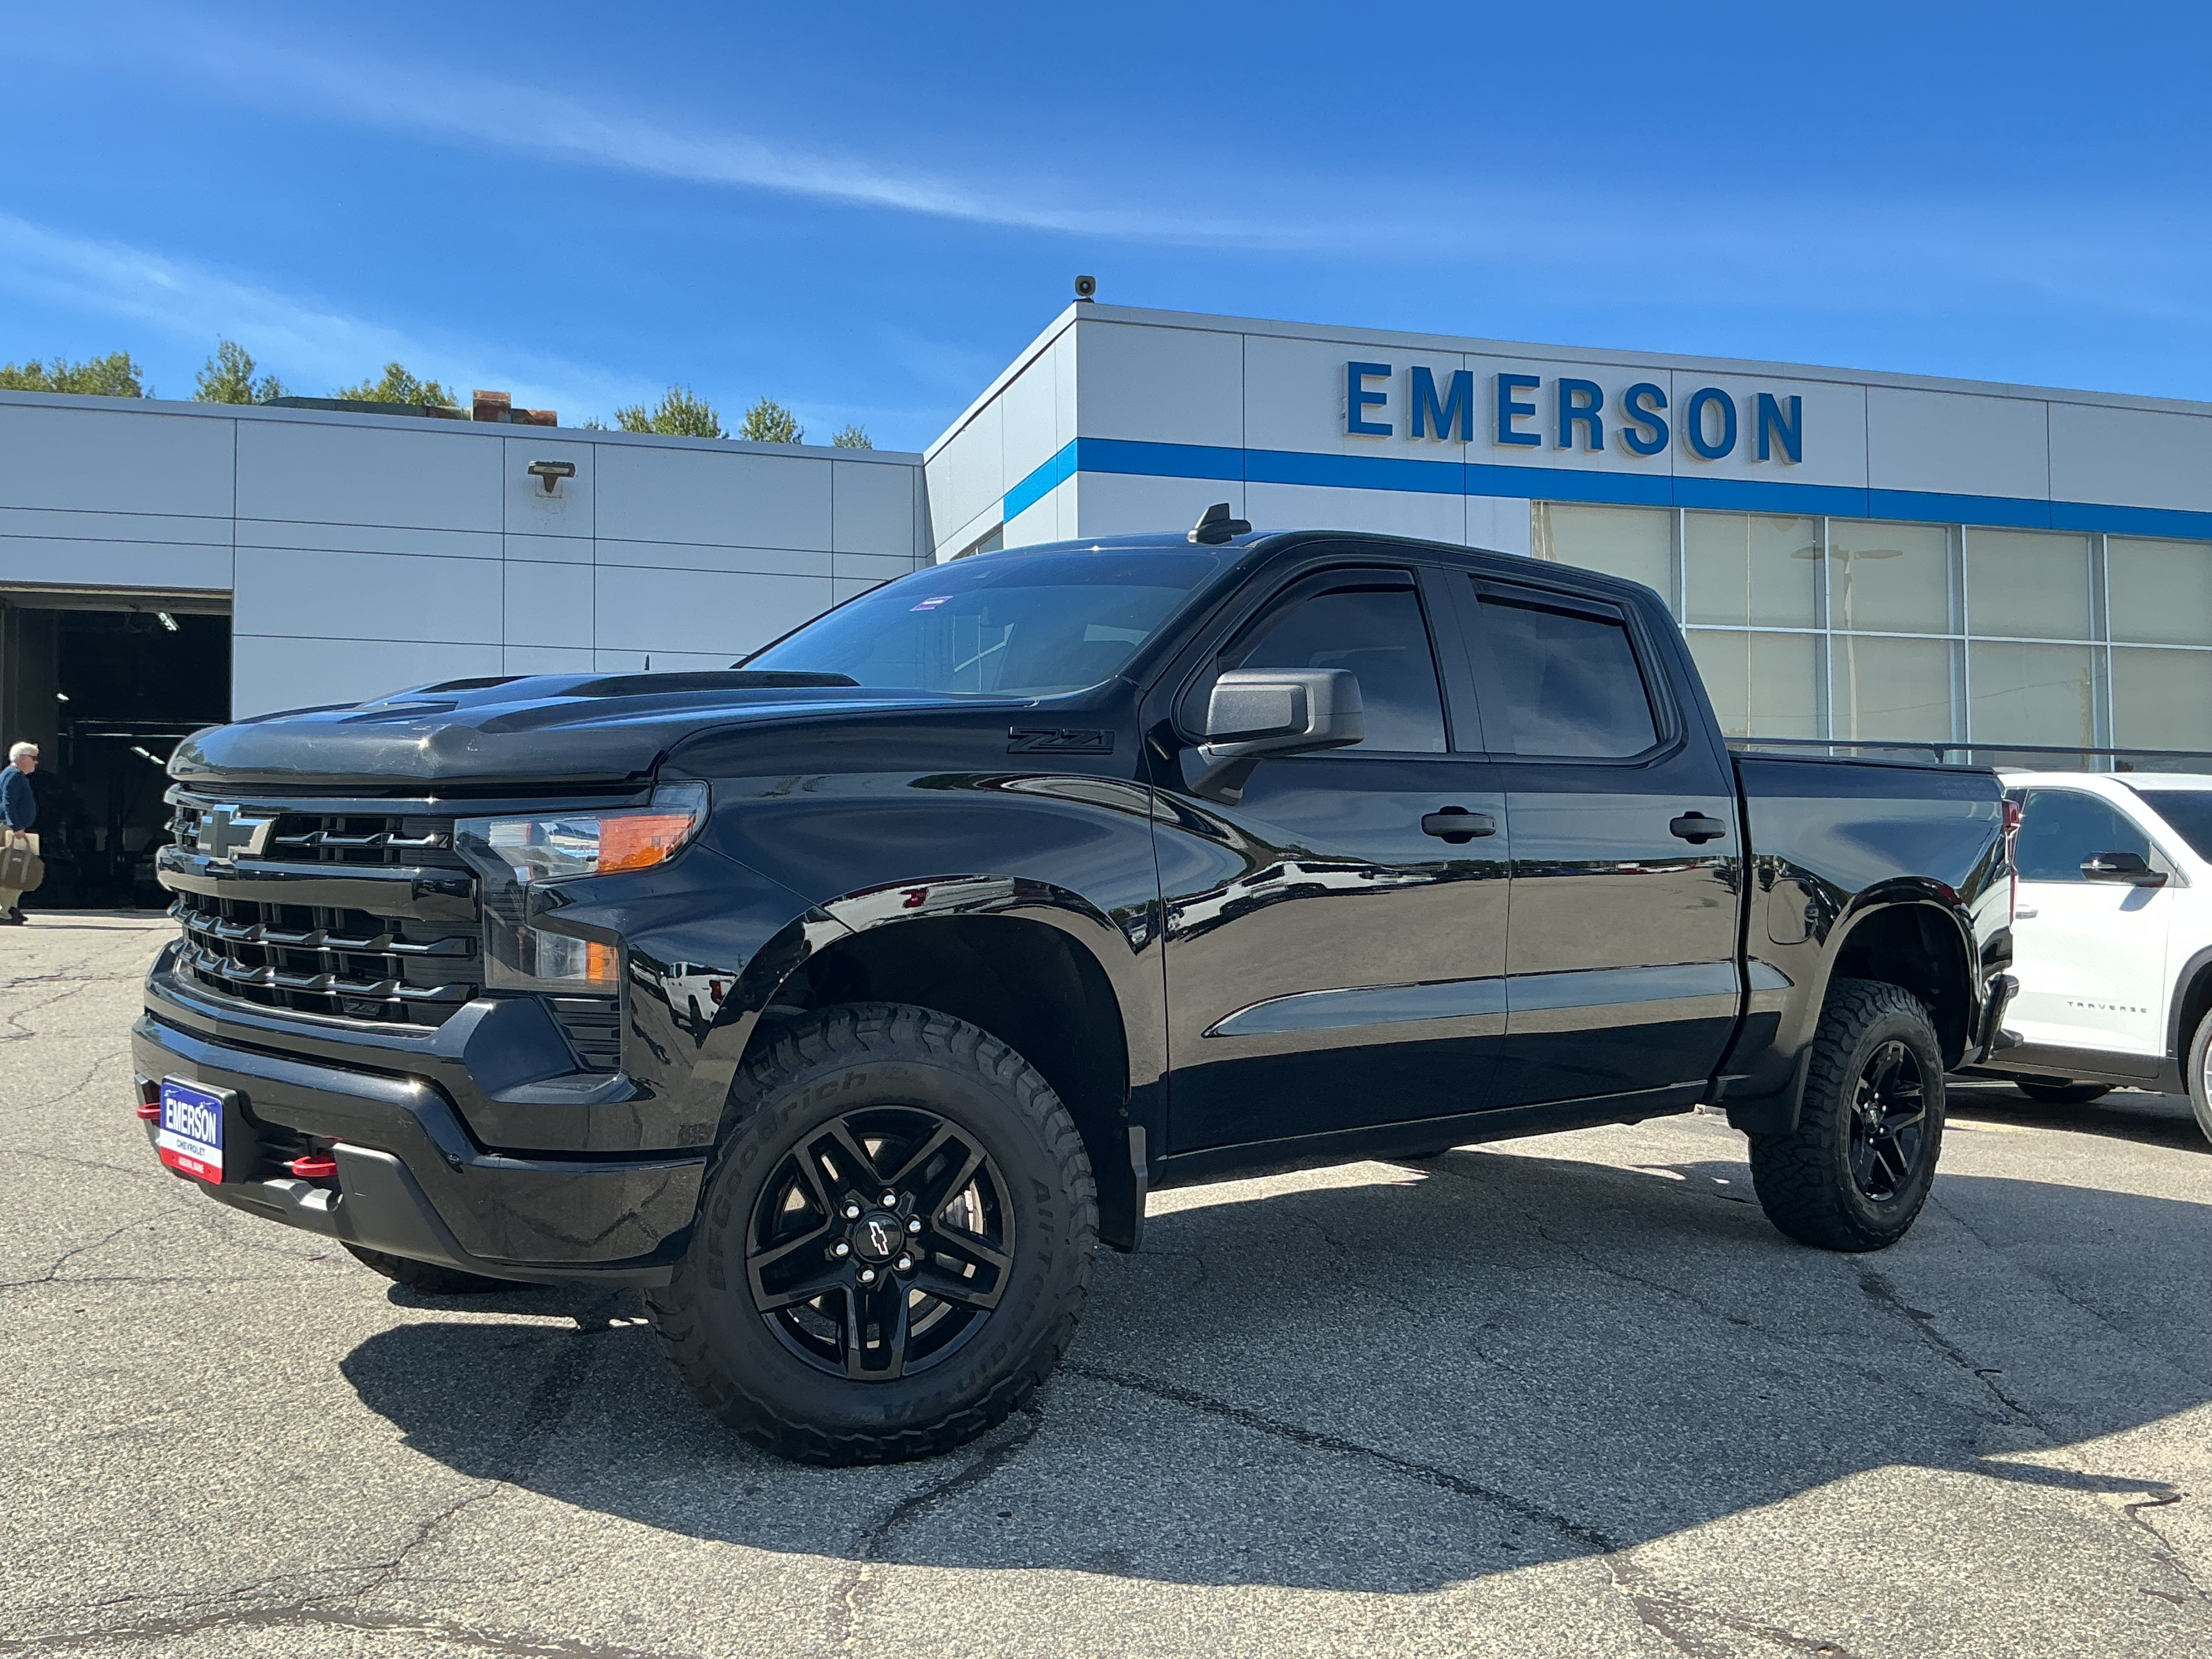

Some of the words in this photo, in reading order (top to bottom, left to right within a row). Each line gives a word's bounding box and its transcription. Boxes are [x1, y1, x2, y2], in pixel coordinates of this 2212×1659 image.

[1344, 361, 1802, 465] EMERSON
[2067, 1001, 2147, 1013] TRAVERSE
[166, 1098, 216, 1144] EMERSON
[177, 1138, 206, 1156] CHEVROLET
